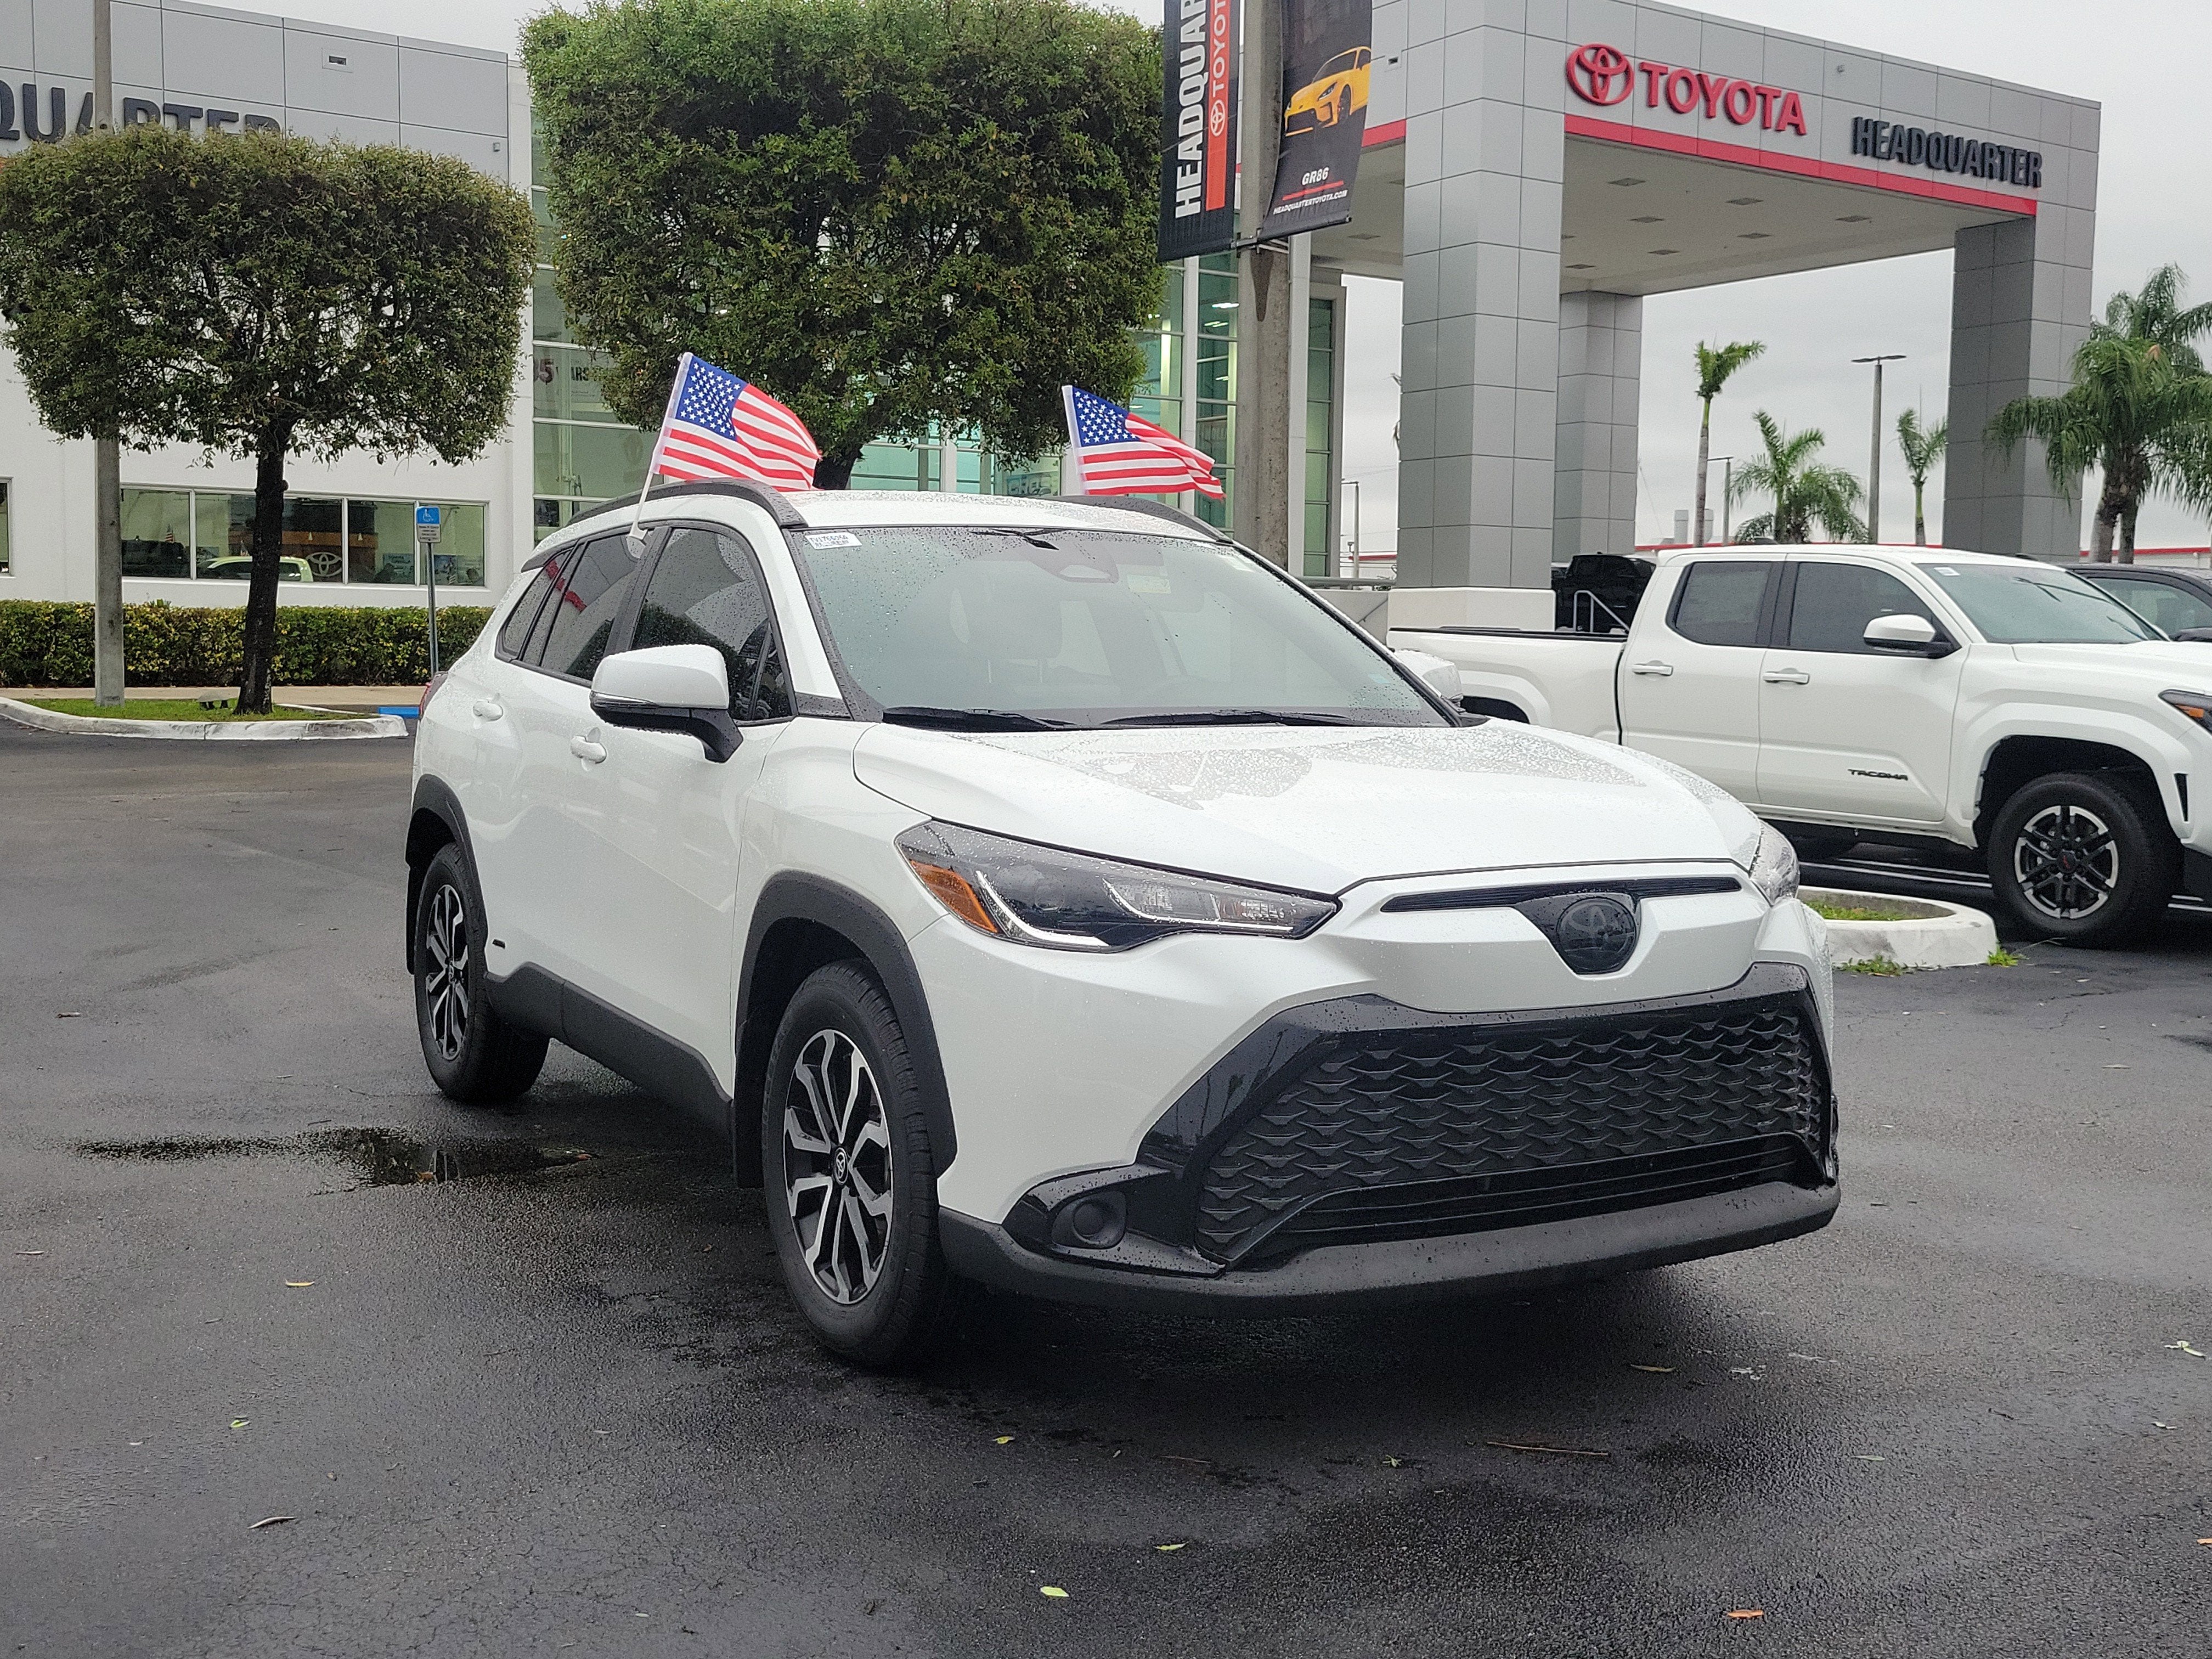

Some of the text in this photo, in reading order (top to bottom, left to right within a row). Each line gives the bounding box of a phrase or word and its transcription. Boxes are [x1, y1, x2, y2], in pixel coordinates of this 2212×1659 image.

[1639, 61, 1807, 136] TOYOTA
[1851, 116, 2042, 188] HEADQUARTER
[1302, 167, 1329, 185] GR86
[1847, 769, 1908, 781] TACOMA
